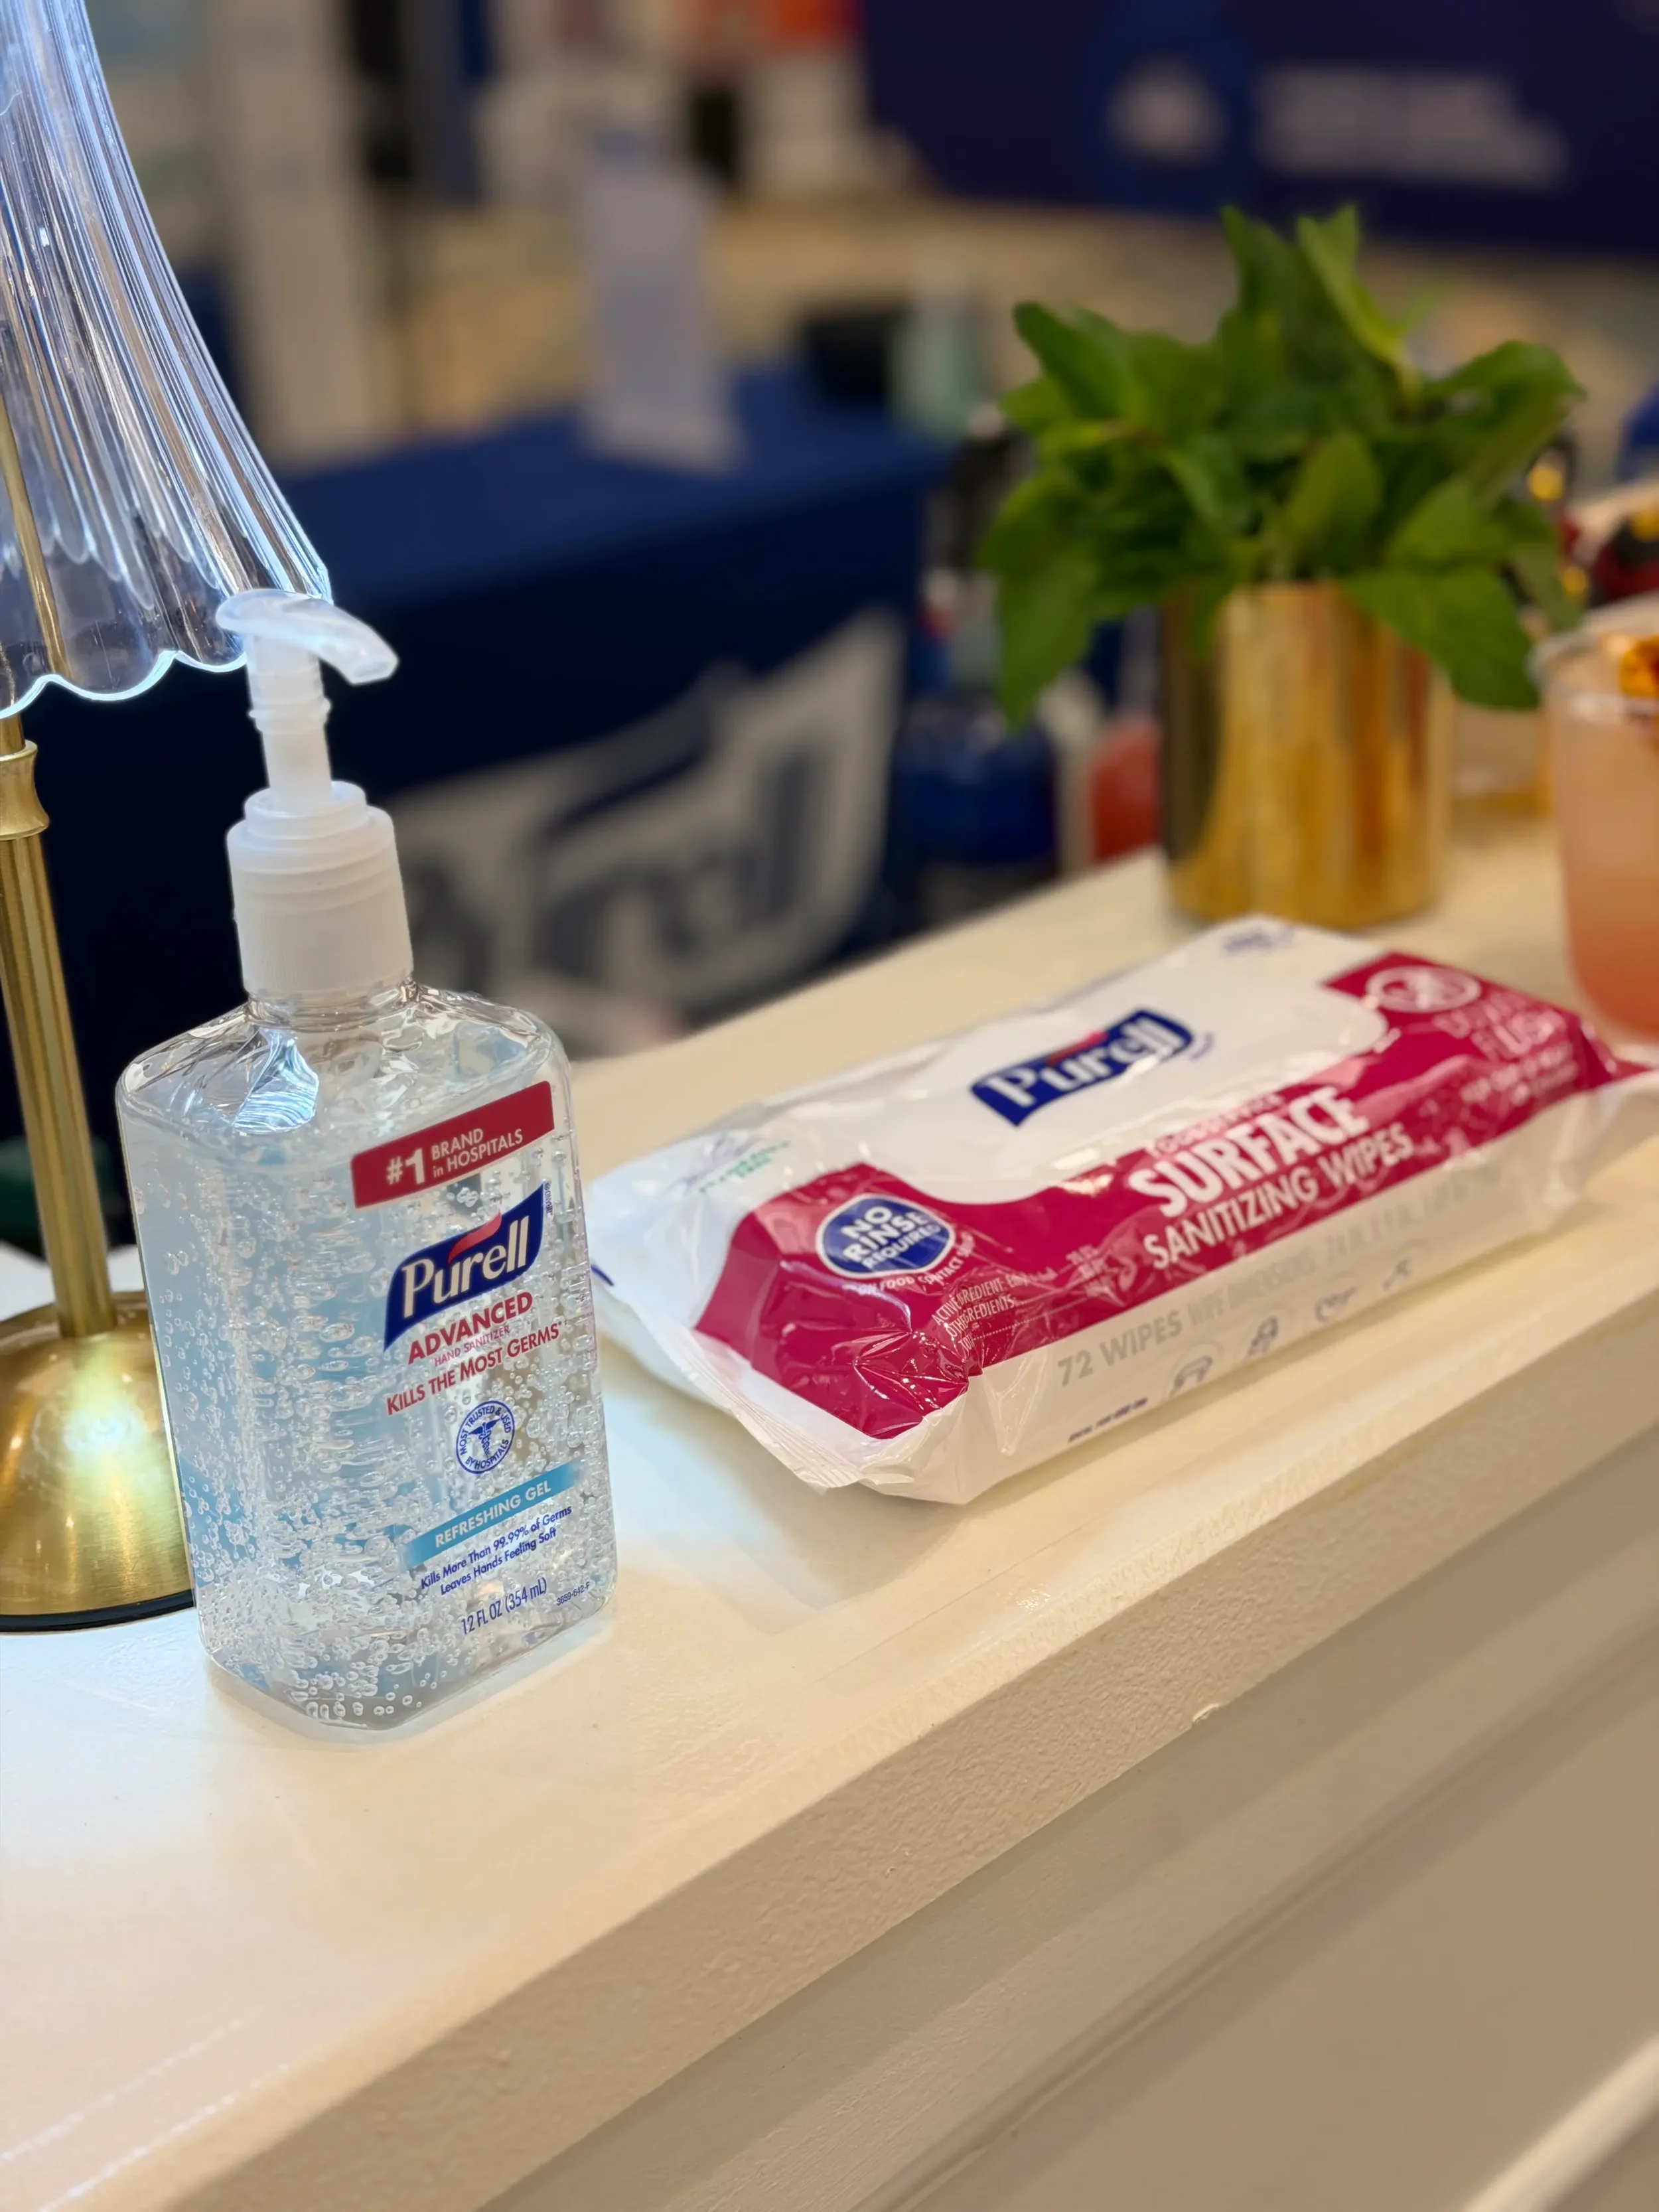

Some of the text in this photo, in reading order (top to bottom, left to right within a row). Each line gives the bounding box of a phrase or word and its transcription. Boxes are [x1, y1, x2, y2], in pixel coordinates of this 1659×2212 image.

[985, 1016, 1185, 1110] Purell
[386, 1147, 425, 1185] #1
[431, 1128, 484, 1160] BRAND
[433, 1128, 523, 1178] in HOSPITALS
[1128, 1086, 1370, 1218] SURFACE
[1143, 1166, 1319, 1270] SANITIZING
[1317, 1122, 1415, 1189] WIPES
[840, 1205, 893, 1240] NO
[842, 1211, 929, 1263] RINSE
[861, 1224, 942, 1270] REQUIRED
[401, 1215, 530, 1319] Purell
[879, 1275, 916, 1292] FOOD
[918, 1255, 965, 1286] CONTACT
[408, 1291, 534, 1365] ADVANCED
[931, 1297, 962, 1327] ACTIVE
[945, 1314, 969, 1338] OTHE
[434, 1325, 510, 1367] HAND SANITIZER
[1056, 1349, 1095, 1388] 72
[1099, 1309, 1184, 1367] WIPES
[387, 1384, 425, 1415] KILLS
[429, 1370, 456, 1395] THE
[460, 1347, 503, 1382] MOST
[459, 1406, 511, 1455] MOST TRUSTED & USED
[465, 1439, 509, 1469] BY HOSPITALS
[435, 1480, 551, 1548] REFRESHING GEL
[421, 1506, 572, 1589] Kills More Than 99.99% of Germs
[440, 1526, 557, 1595] Leaves Hands Feeling Soft
[461, 1576, 547, 1635] 12 FL OZ (354 mL)
